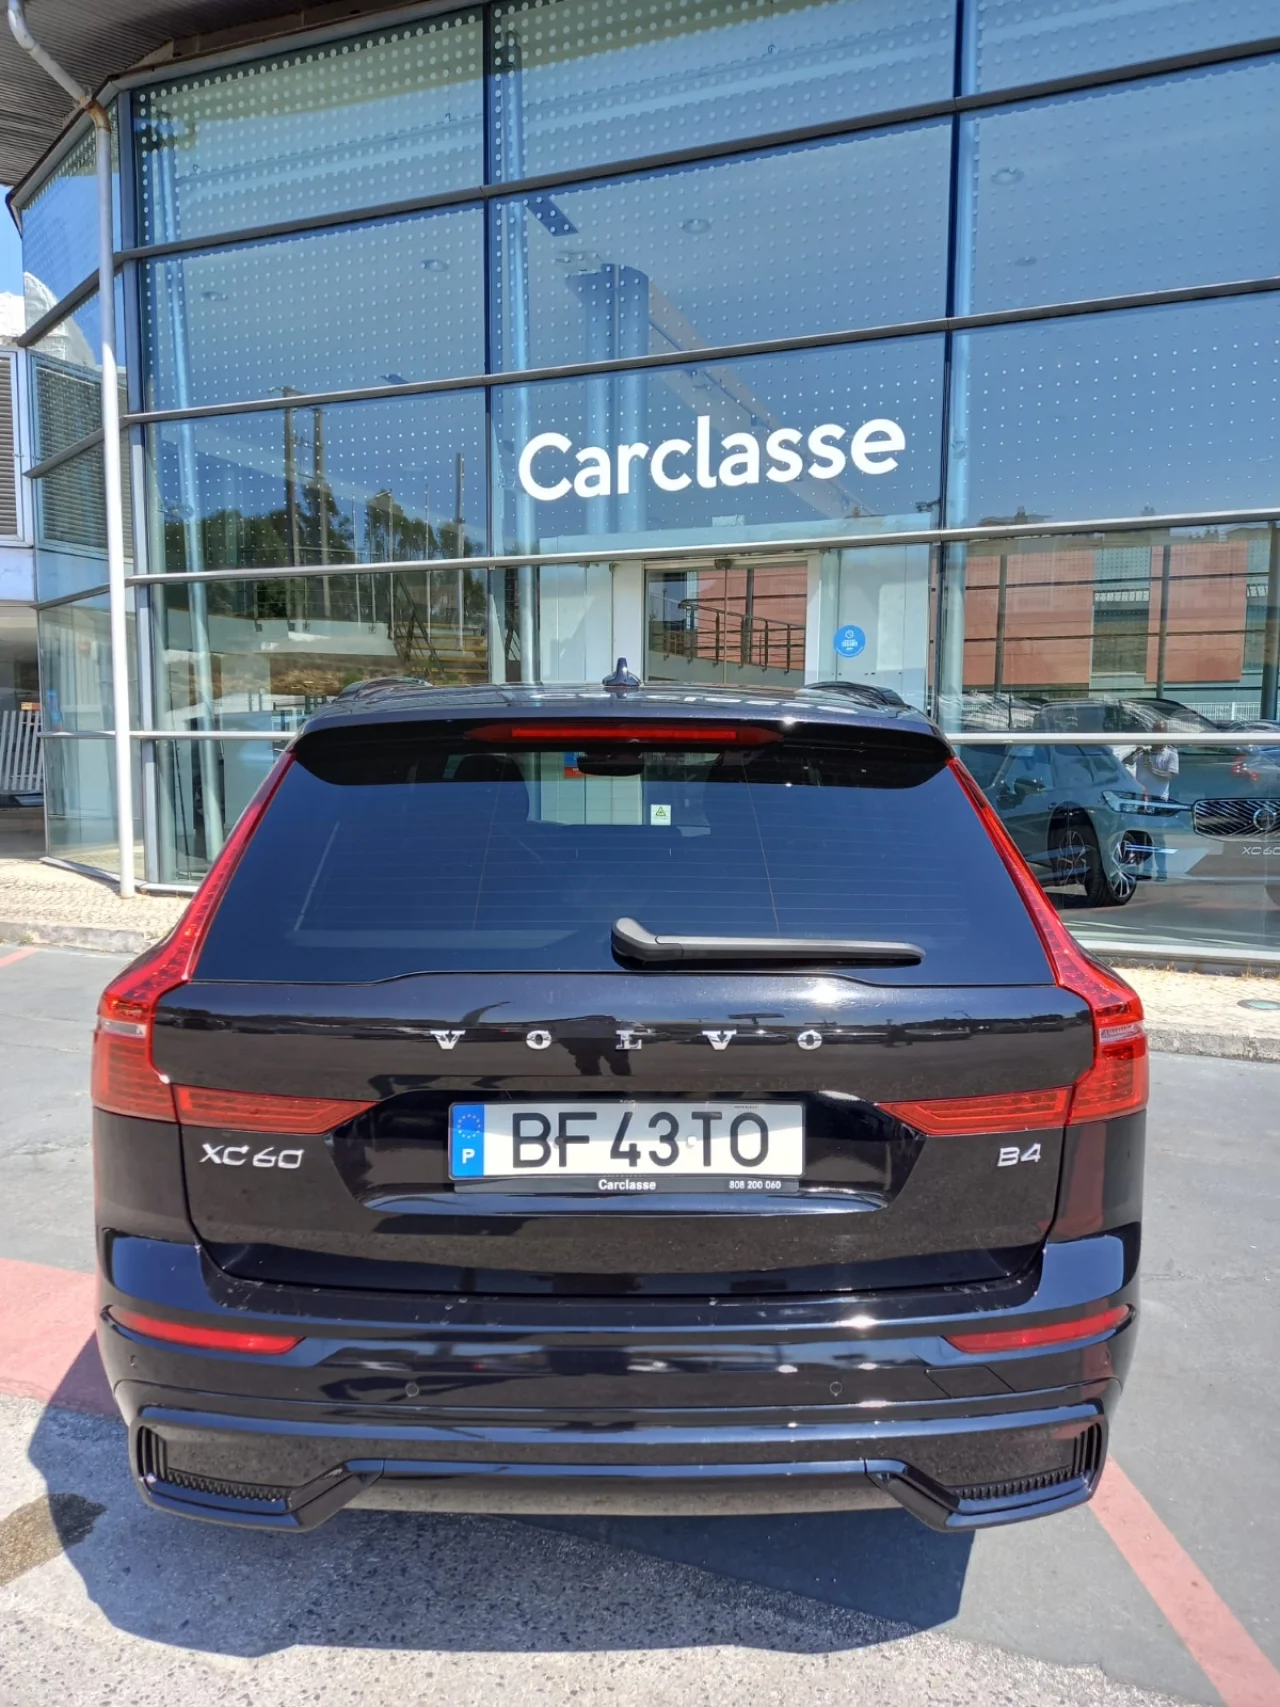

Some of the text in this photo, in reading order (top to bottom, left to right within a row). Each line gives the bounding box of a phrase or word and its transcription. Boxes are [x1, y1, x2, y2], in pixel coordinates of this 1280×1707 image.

[518, 414, 907, 501] Carclasse
[429, 1029, 823, 1051] VOLVO
[512, 1111, 769, 1169] BF 43 TO
[462, 1148, 475, 1164] P
[996, 1142, 1041, 1167] B4
[597, 1178, 657, 1190] Carclasse
[729, 1180, 781, 1190] 808 200 060
